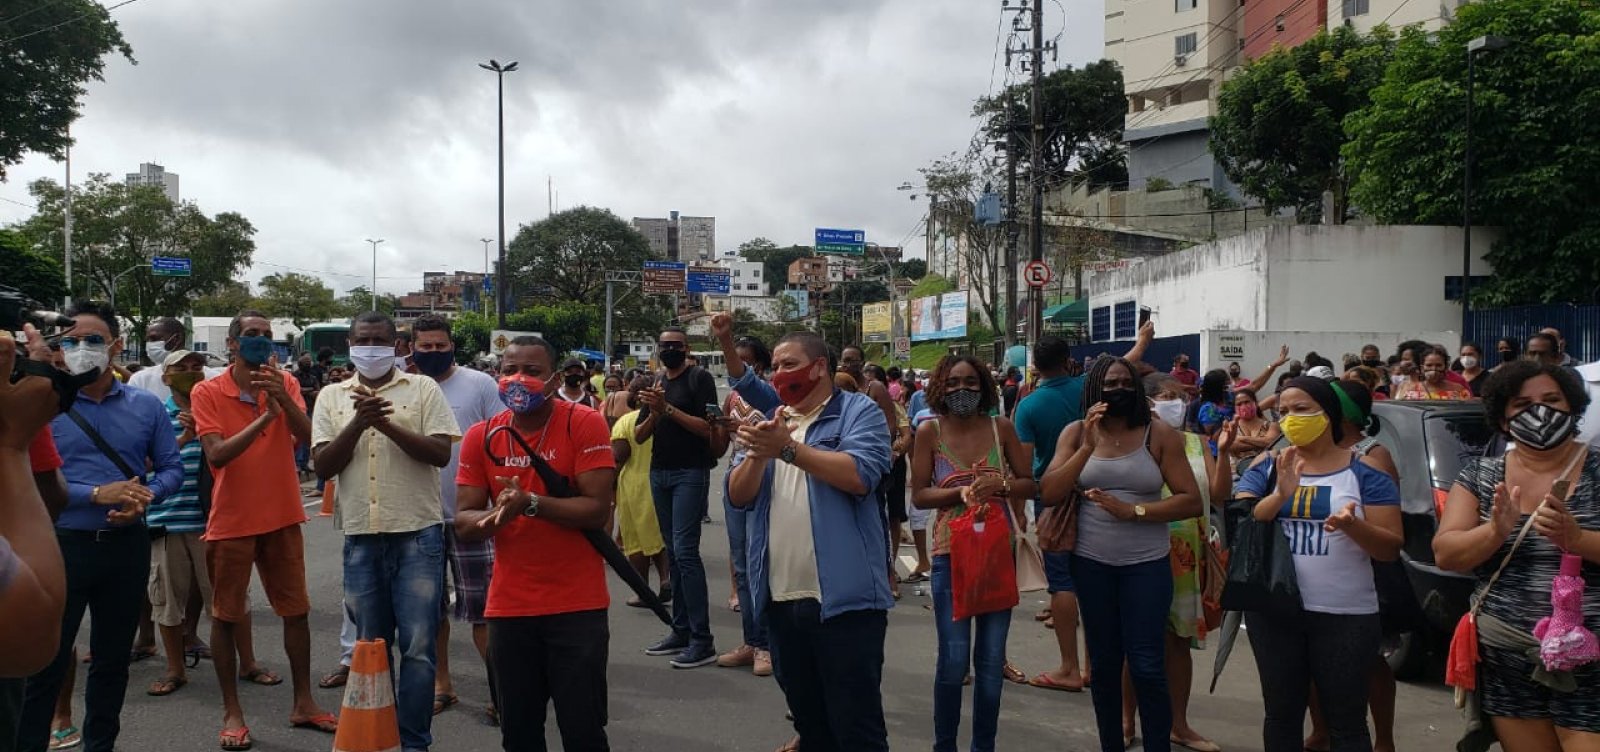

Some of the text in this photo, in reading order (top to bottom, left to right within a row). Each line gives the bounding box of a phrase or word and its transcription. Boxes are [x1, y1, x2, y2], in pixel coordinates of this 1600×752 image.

[1219, 344, 1244, 354] SAÍDA
[1291, 485, 1318, 518] IT
[1284, 520, 1330, 557] IRL
